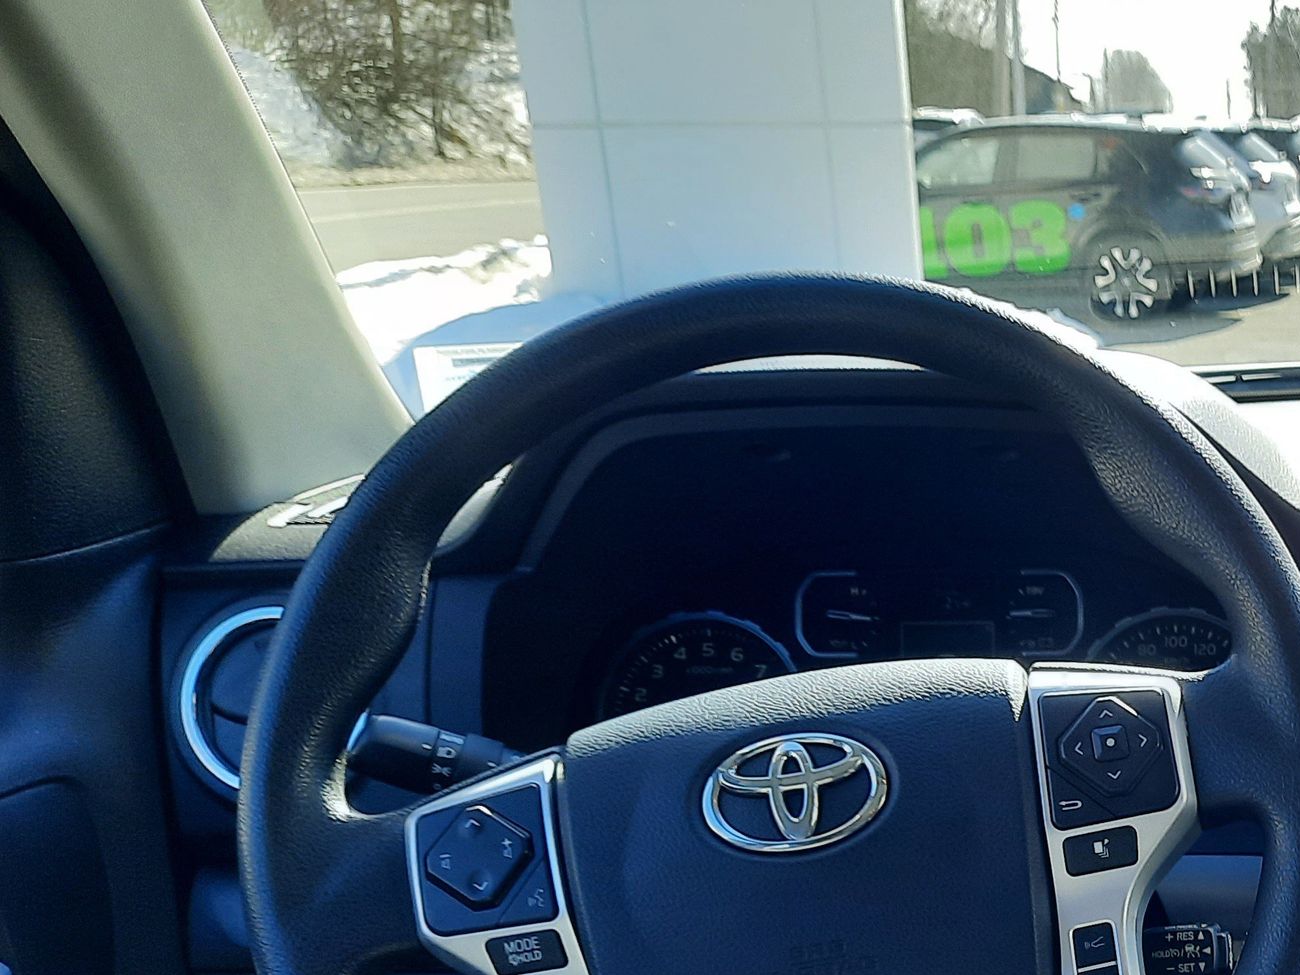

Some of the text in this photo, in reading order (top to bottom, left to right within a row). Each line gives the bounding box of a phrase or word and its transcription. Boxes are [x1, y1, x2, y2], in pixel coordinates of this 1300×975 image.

[1176, 931, 1195, 941] RES
[504, 936, 541, 953] MODE
[1178, 962, 1195, 973] SET
